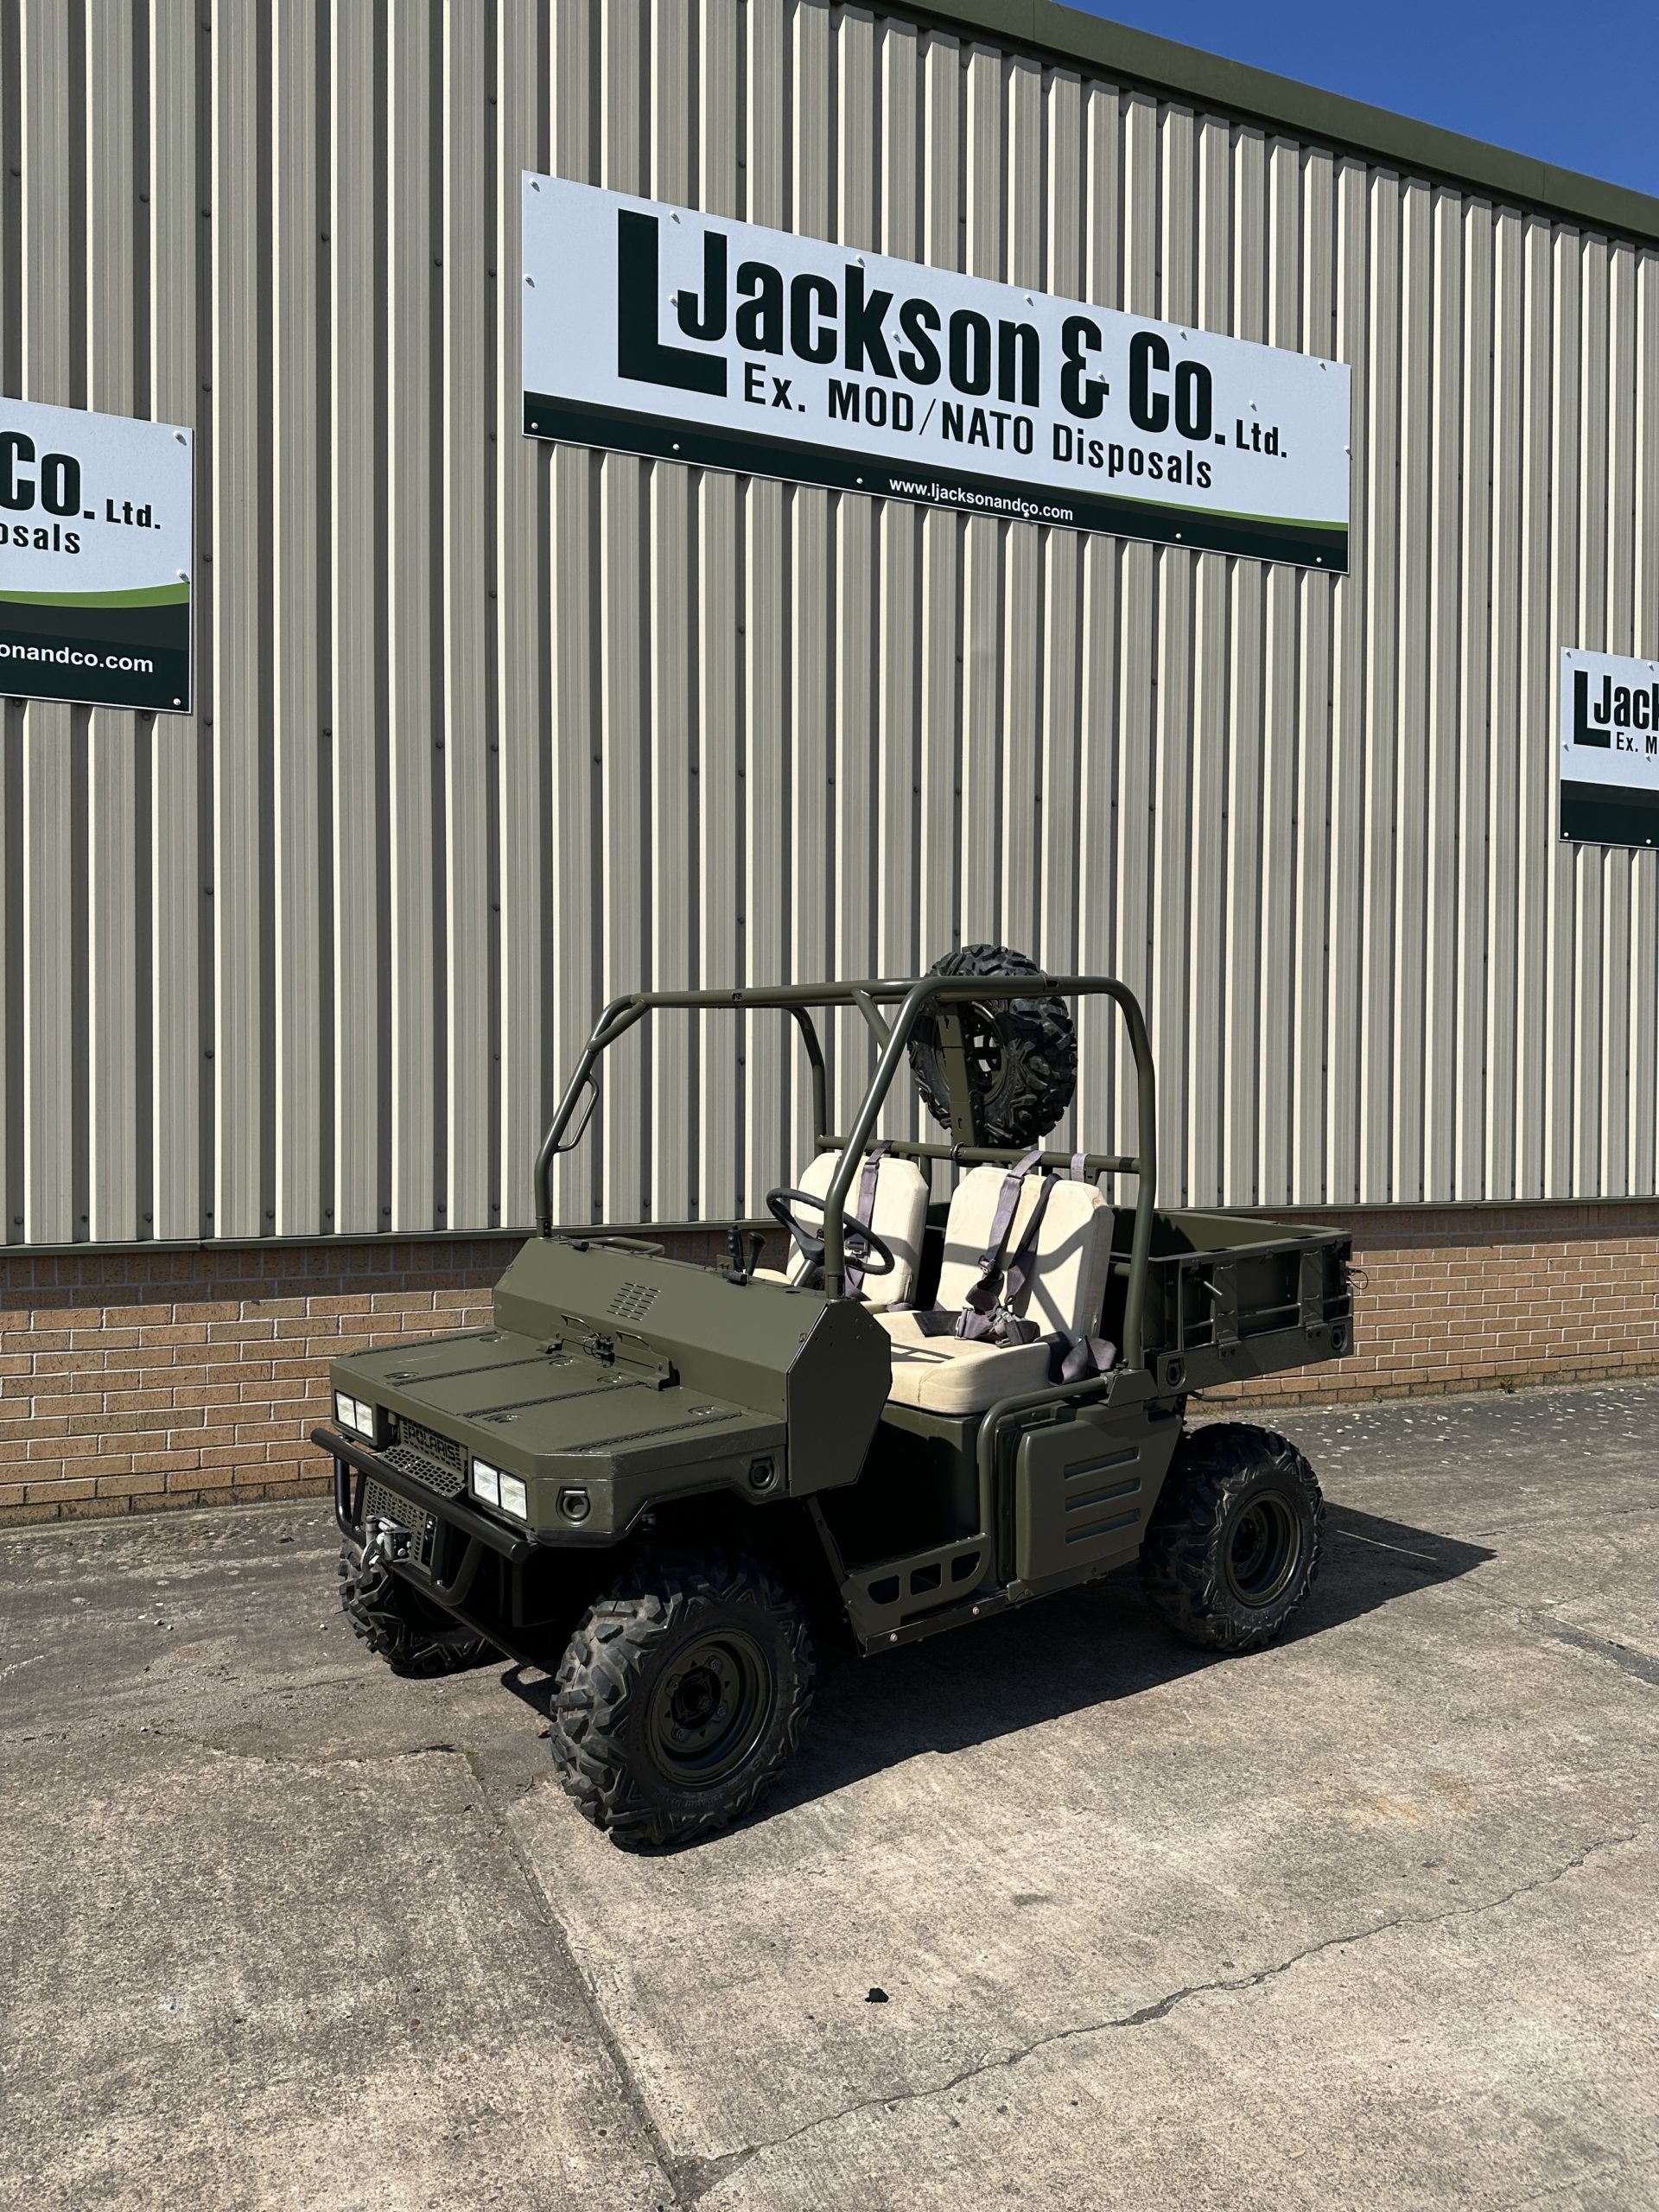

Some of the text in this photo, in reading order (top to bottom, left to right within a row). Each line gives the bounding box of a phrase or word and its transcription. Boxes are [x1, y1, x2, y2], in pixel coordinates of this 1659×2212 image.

[1061, 316, 1109, 420] &
[1129, 332, 1226, 445] Co.
[1236, 419, 1287, 458] Ltd.
[744, 361, 1211, 489] Ex. MOD/NATO Disposals
[0, 431, 162, 529] Co. Ltd.
[889, 479, 1073, 521] www.ljacksonandco.com
[1617, 732, 1638, 753] Ex.
[407, 1424, 456, 1462] POLARIS
